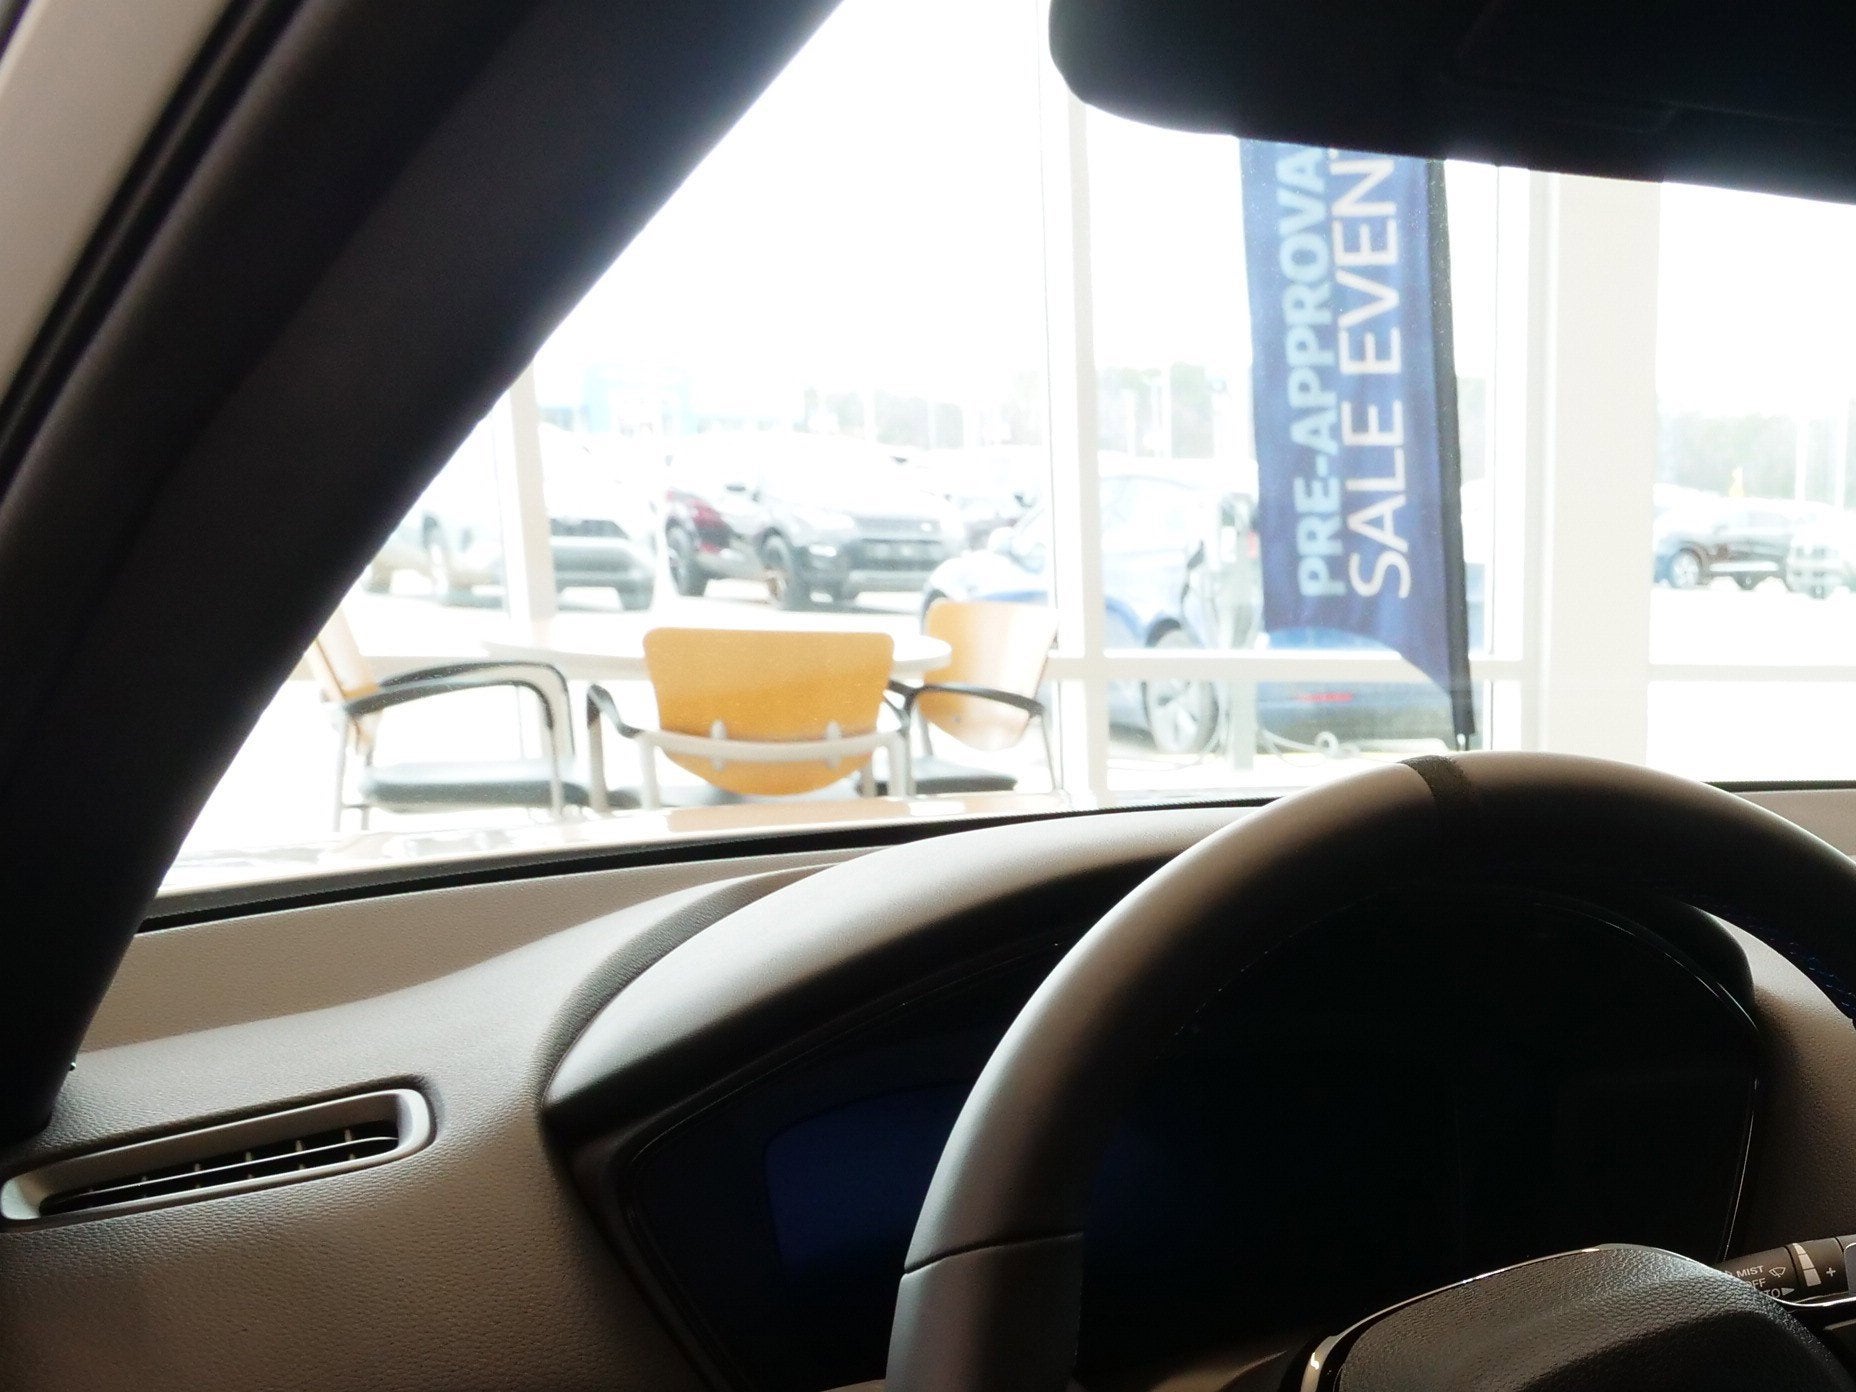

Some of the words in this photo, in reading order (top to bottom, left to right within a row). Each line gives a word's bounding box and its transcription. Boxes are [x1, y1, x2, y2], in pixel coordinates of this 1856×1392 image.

[1327, 148, 1401, 374] EVEN
[1276, 145, 1347, 597] PRE-APPROVA
[1341, 400, 1411, 599] SALE
[1736, 1265, 1764, 1278] MIST
